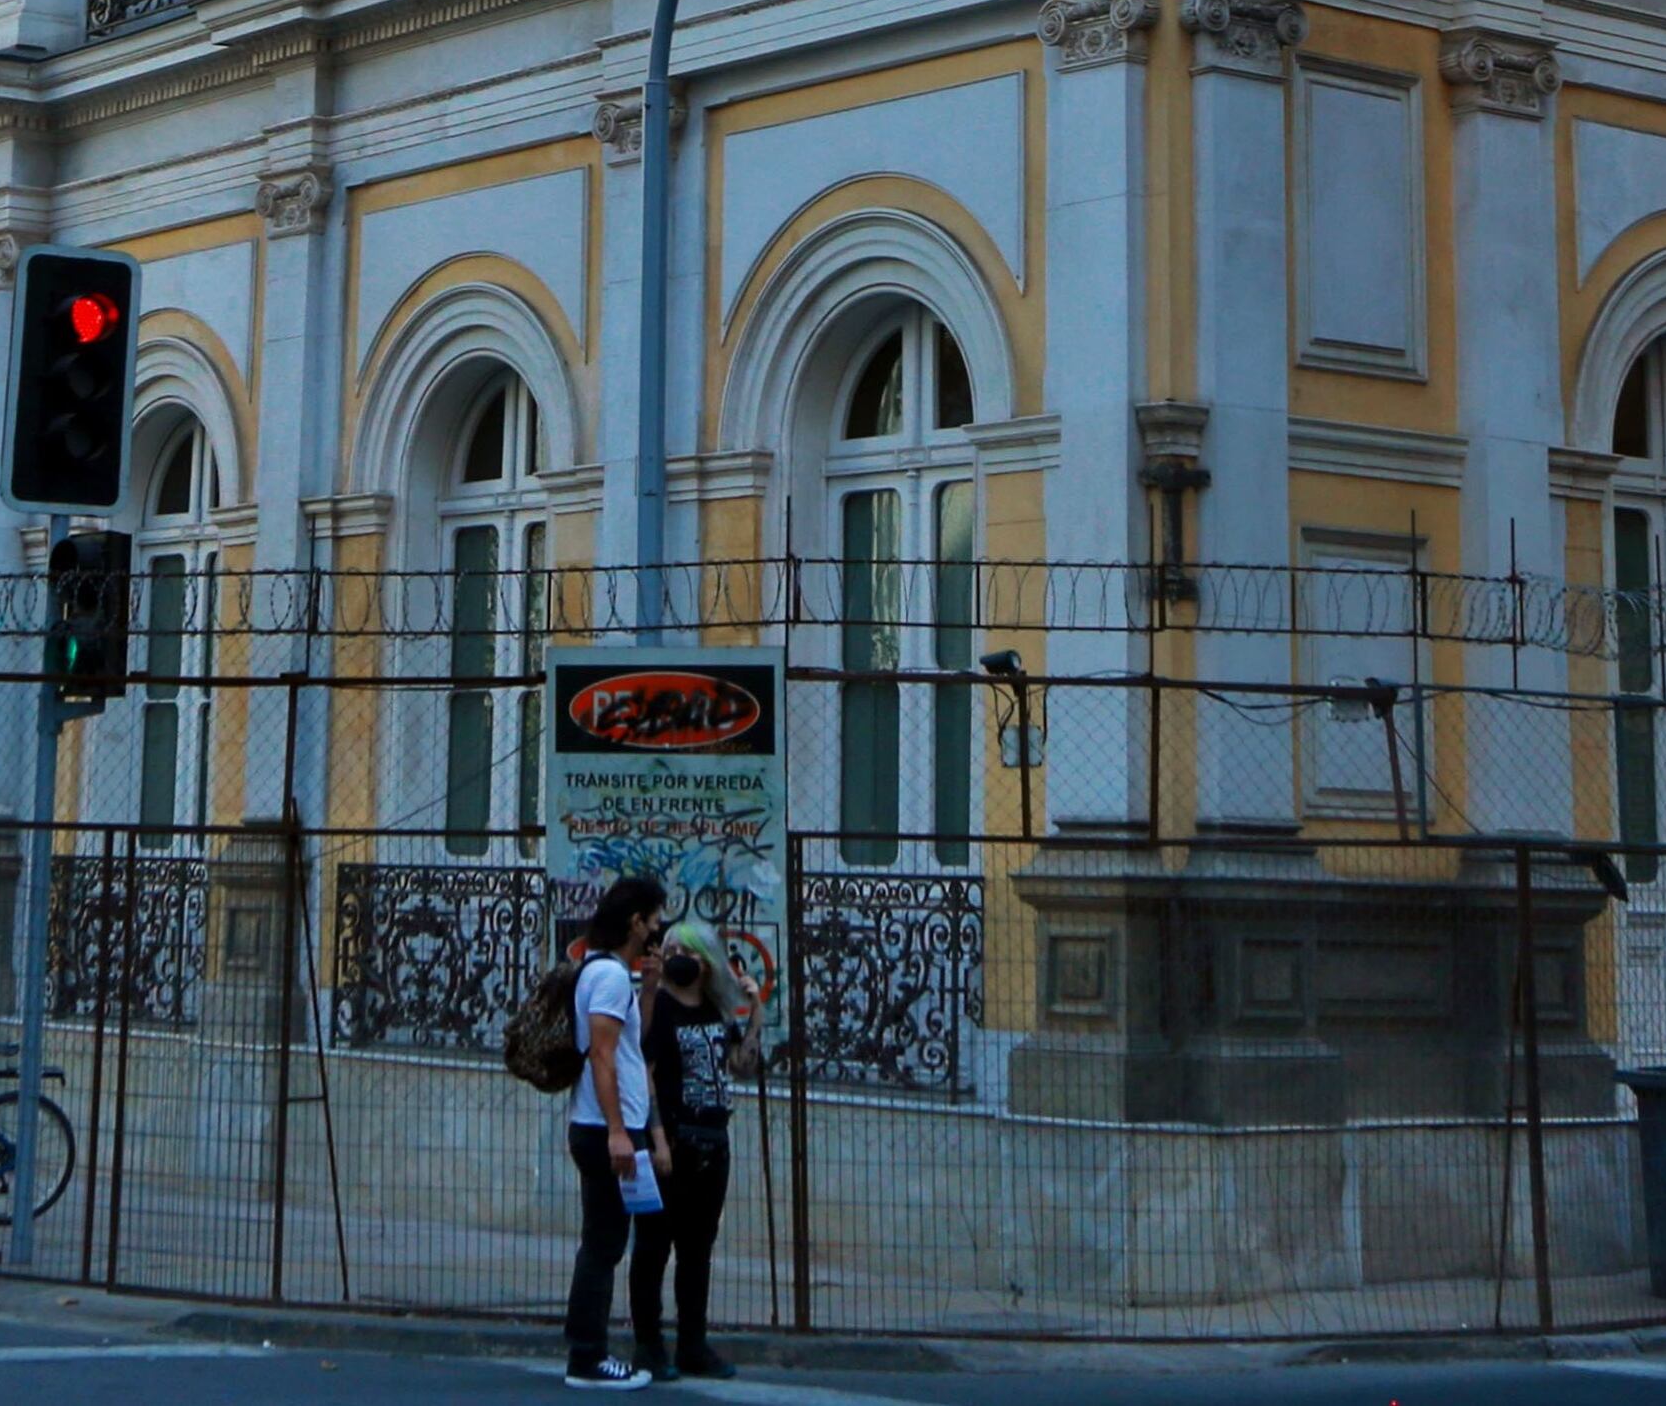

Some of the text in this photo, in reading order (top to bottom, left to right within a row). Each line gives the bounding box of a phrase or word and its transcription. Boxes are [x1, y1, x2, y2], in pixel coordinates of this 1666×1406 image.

[652, 774, 688, 789] POR
[693, 774, 764, 791] VEREDA
[602, 796, 725, 813] DE EN FRENTE
